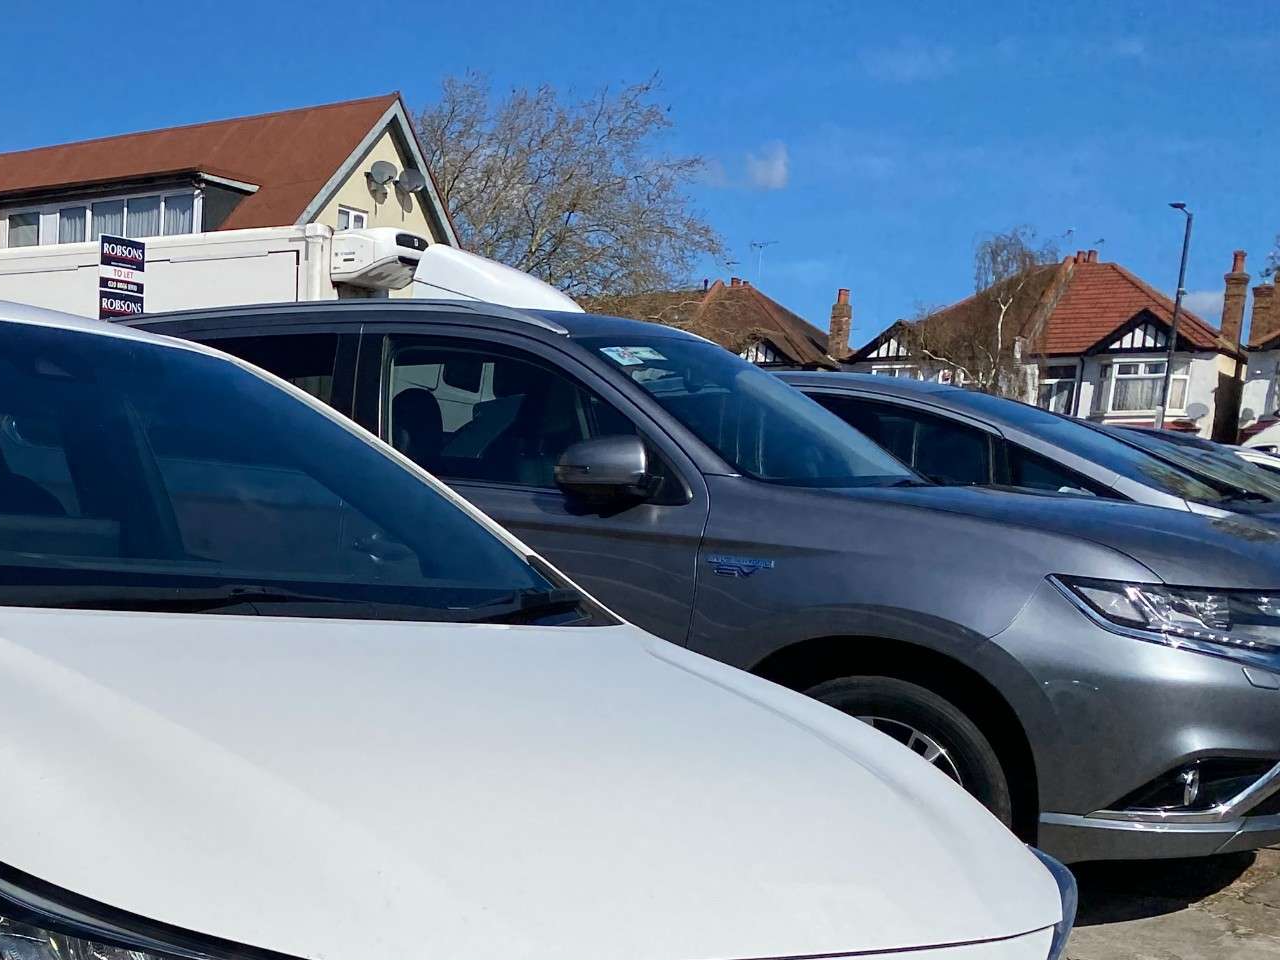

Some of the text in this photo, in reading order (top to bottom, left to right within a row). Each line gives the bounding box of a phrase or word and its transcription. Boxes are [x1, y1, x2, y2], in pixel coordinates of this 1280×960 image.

[103, 242, 143, 260] ROBSONS
[113, 268, 134, 279] TO LET
[101, 297, 142, 313] ROBSONS
